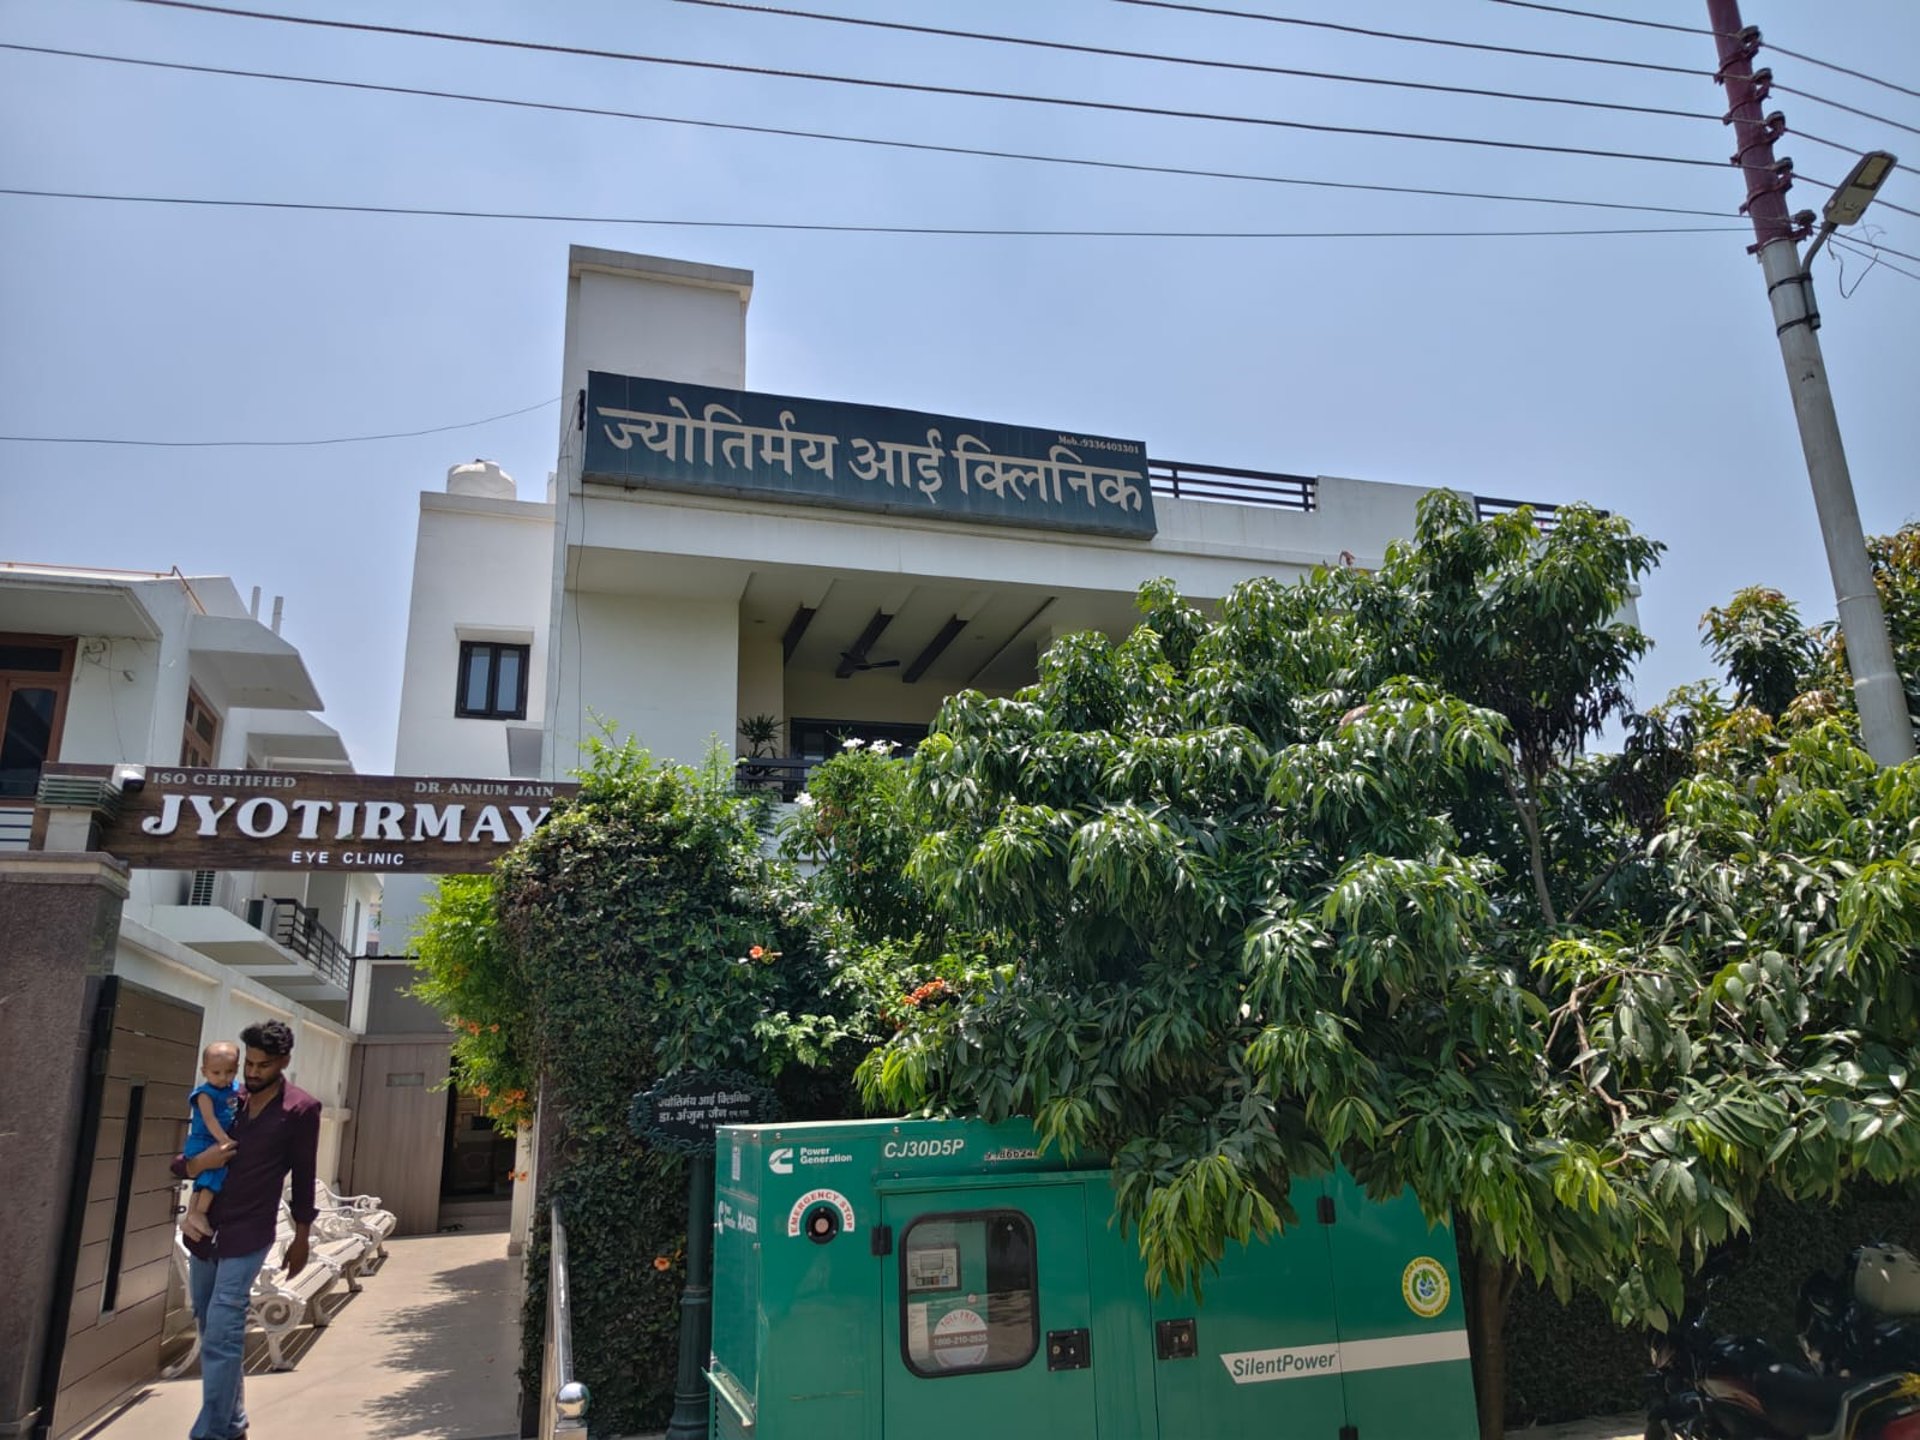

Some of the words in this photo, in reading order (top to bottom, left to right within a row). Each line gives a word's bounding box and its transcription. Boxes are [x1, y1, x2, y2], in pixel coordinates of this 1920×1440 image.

[596, 396, 839, 480] ज्योतिर्मय
[848, 428, 945, 503] आई
[951, 434, 1143, 512] क्लिनिक
[153, 772, 187, 784] ISO
[193, 774, 297, 788] CERTIFIED
[414, 782, 444, 793] DR.
[450, 783, 508, 796] ANJUM
[514, 785, 554, 797] JAIN
[141, 794, 551, 843] JYOTIRMAY
[291, 851, 329, 864] EYE
[343, 852, 404, 865] CLINIC
[800, 1147, 830, 1156] Power
[884, 1139, 964, 1158] CJ30D5P
[800, 1153, 852, 1164] Generation
[790, 1190, 840, 1234] EMERGENCY
[839, 1200, 853, 1229] STOP
[1233, 1353, 1336, 1377] SilentPower
